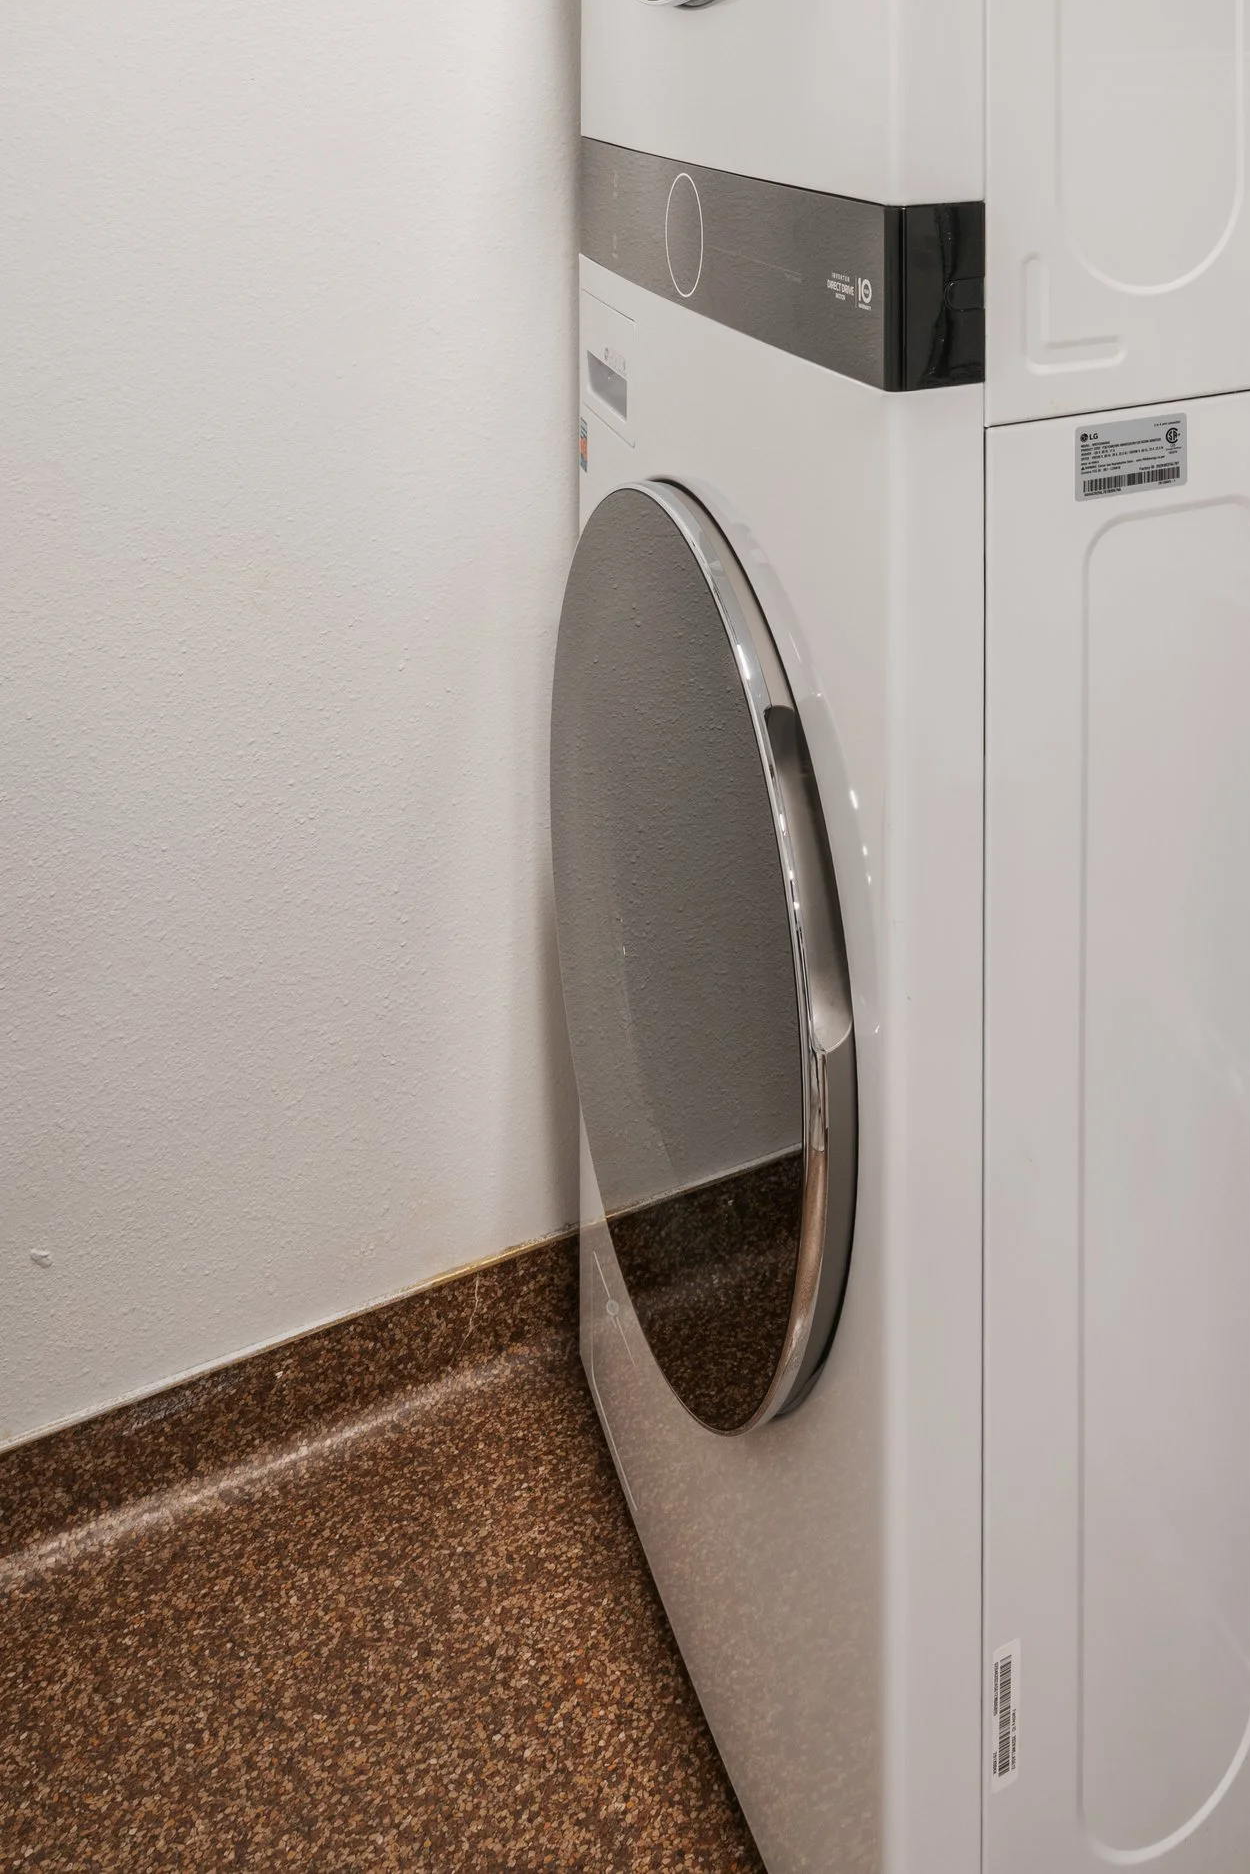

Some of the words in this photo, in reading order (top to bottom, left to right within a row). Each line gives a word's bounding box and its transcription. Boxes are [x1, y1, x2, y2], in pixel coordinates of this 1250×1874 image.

[826, 279, 841, 292] DIRECT
[842, 282, 854, 296] DRIVE
[858, 277, 872, 304] 10
[1089, 432, 1098, 440] LG
